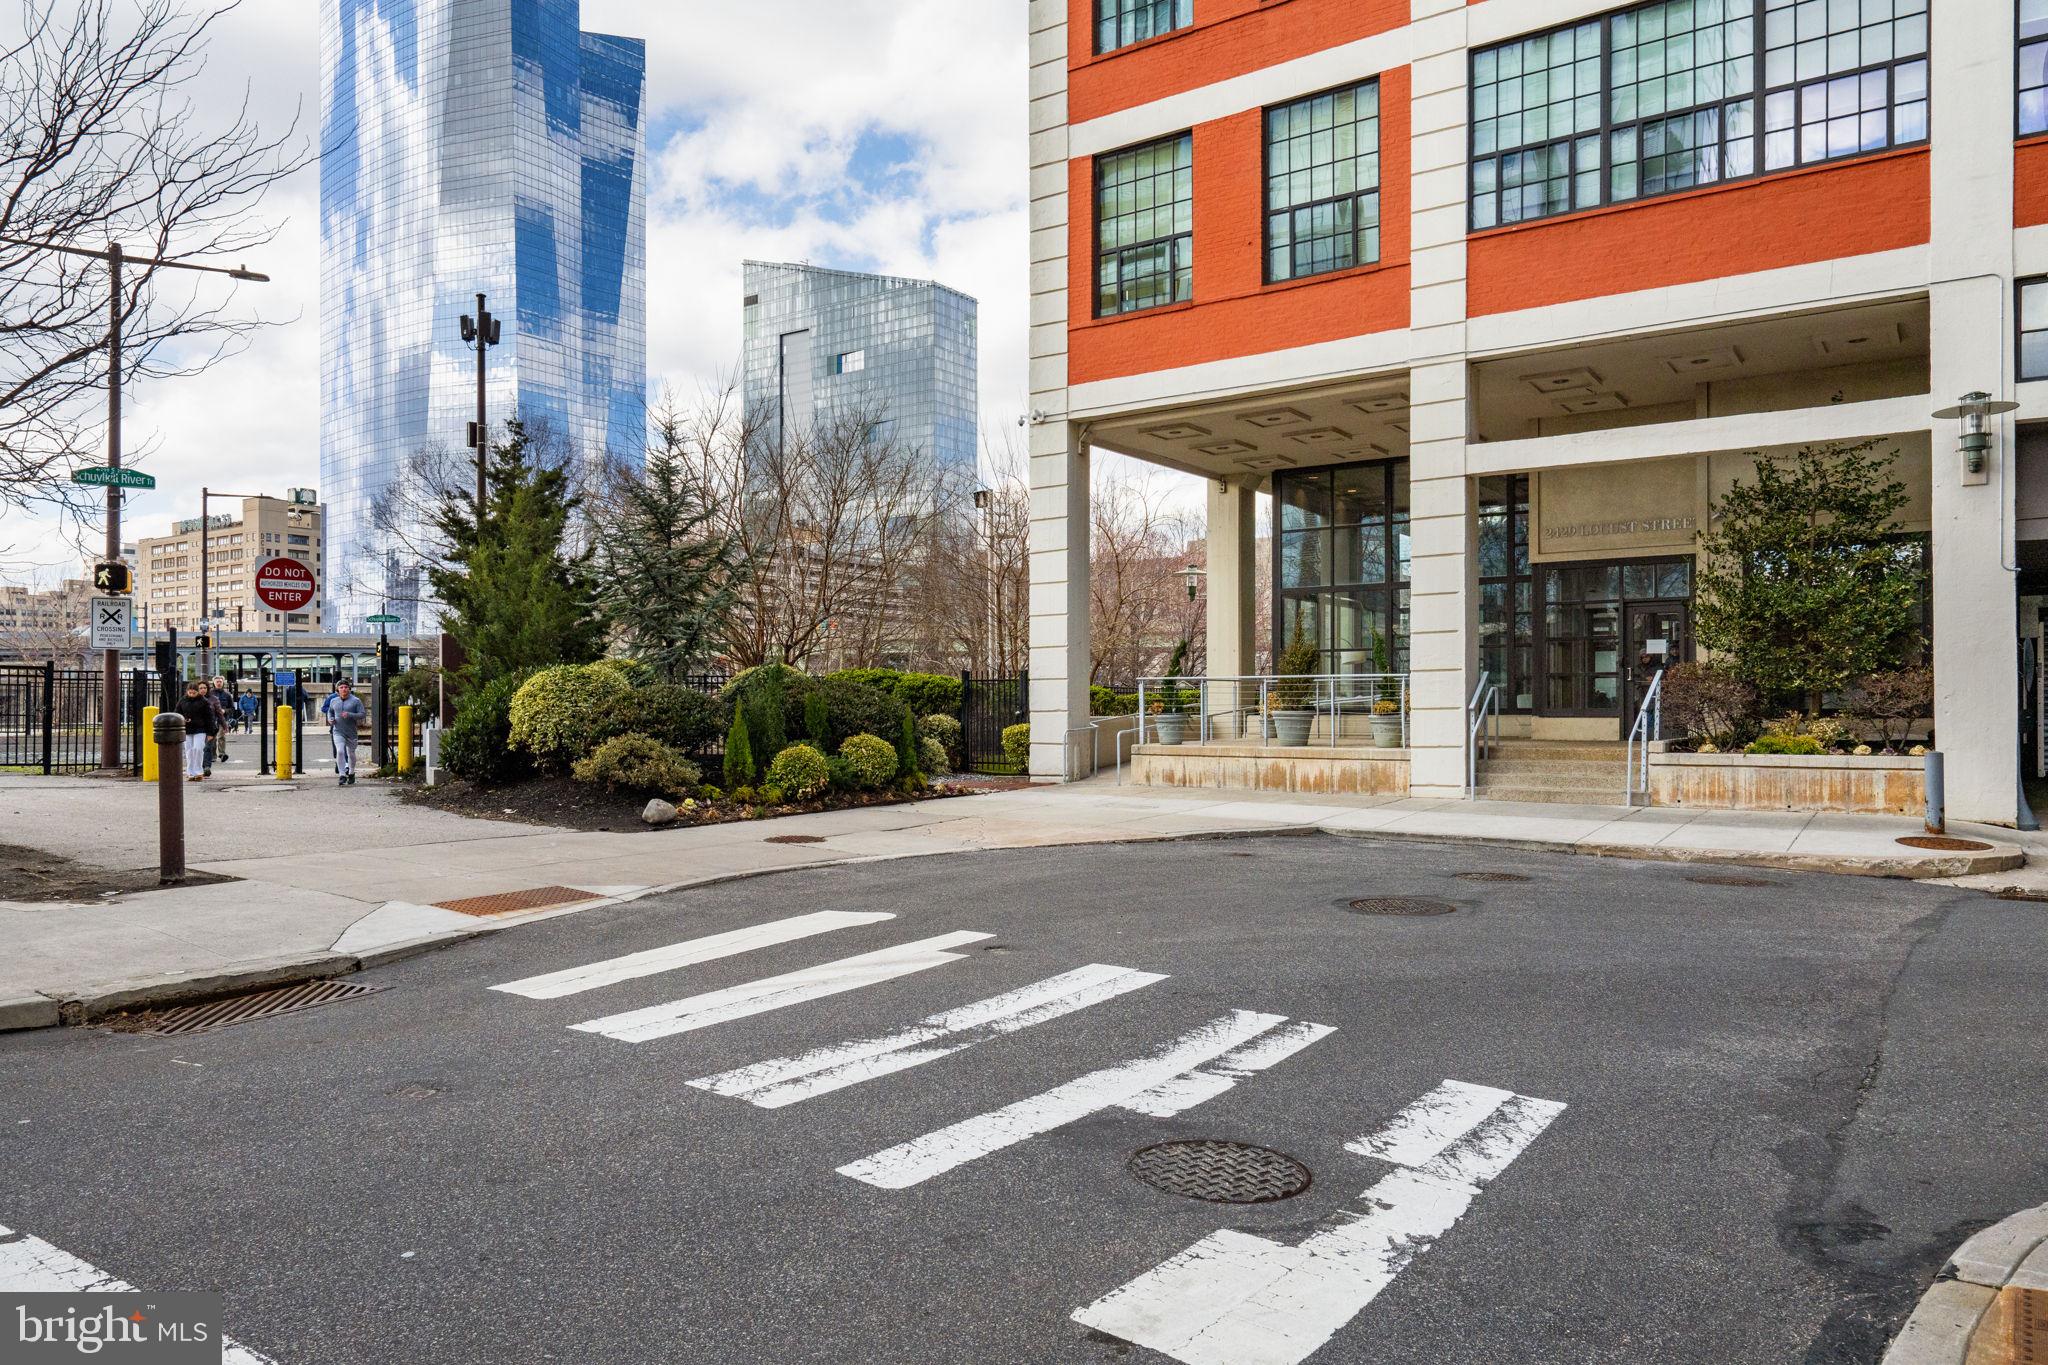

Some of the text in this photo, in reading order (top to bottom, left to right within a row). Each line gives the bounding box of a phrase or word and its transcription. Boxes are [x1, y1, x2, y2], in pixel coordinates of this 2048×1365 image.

[121, 473, 145, 485] River
[1545, 517, 1695, 539] 2429 LOCUST STREE
[265, 567, 306, 578] DO NOT
[269, 592, 302, 601] ENTER
